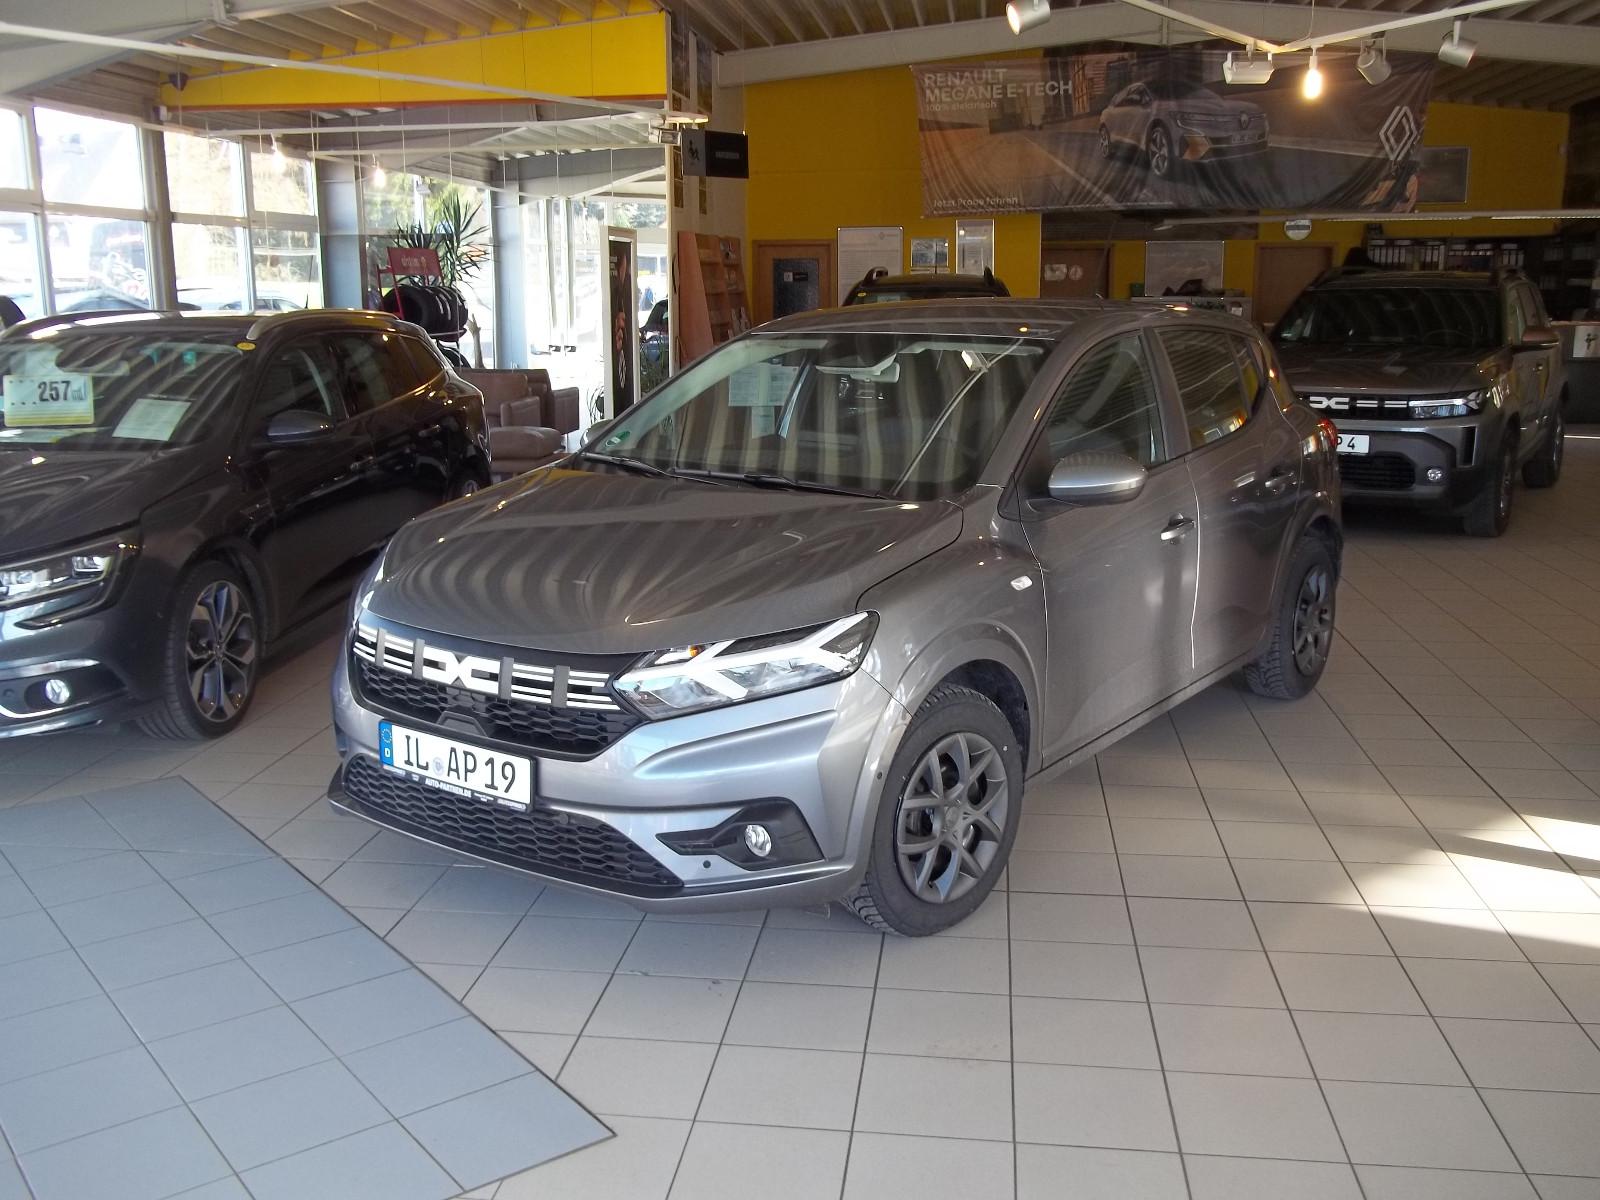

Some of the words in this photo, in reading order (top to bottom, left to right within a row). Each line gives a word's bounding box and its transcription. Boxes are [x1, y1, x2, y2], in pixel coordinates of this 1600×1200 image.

[924, 68, 1008, 88] RENAULT
[924, 83, 1003, 103] MEGANE
[1007, 79, 1073, 98] E-TECH
[37, 380, 71, 402] 257
[1347, 436, 1356, 450] 4
[384, 747, 391, 758] D
[404, 734, 429, 771] IL
[447, 746, 477, 783] AP
[484, 756, 516, 794] 19
